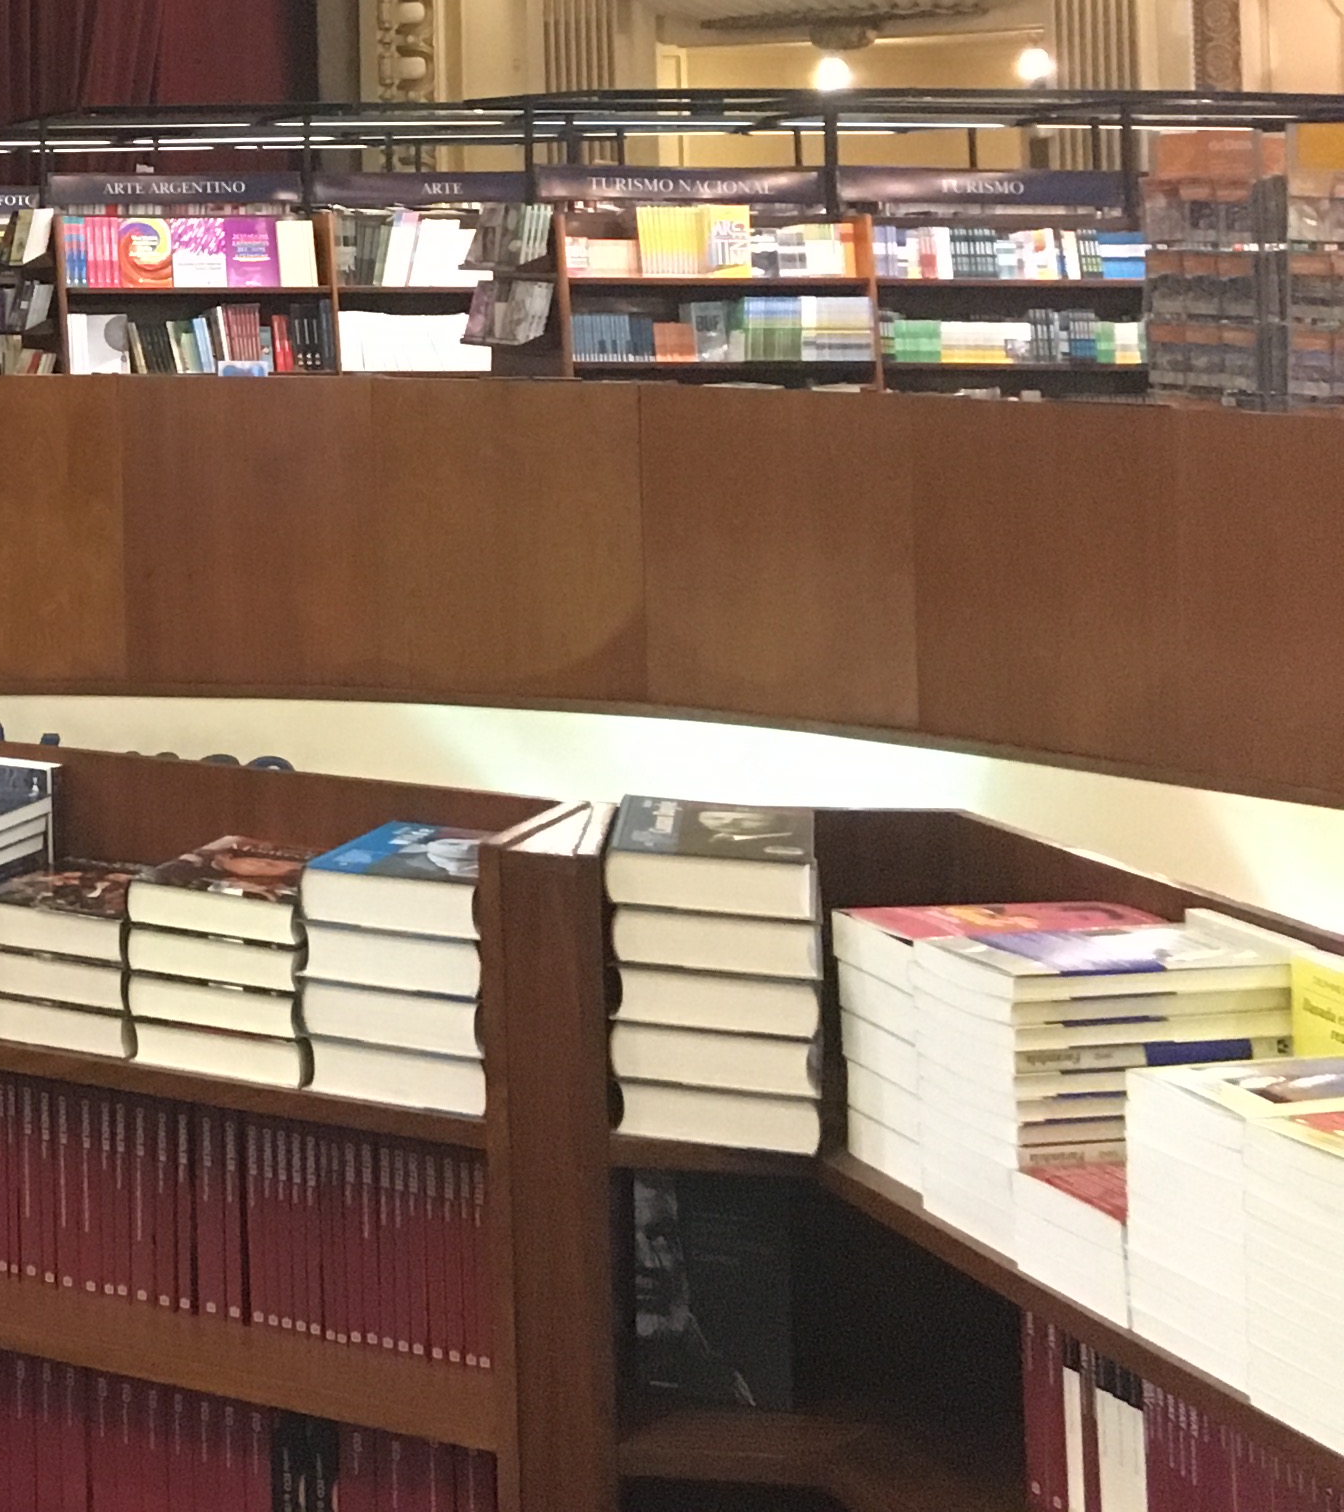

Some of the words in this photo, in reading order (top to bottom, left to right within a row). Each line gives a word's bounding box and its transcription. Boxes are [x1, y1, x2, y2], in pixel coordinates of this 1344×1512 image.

[103, 181, 145, 195] ARTE
[149, 180, 246, 195] ARGENTINO
[420, 182, 463, 196] ARTE
[588, 176, 674, 194] TURISMO
[940, 178, 1025, 196] TURISMO
